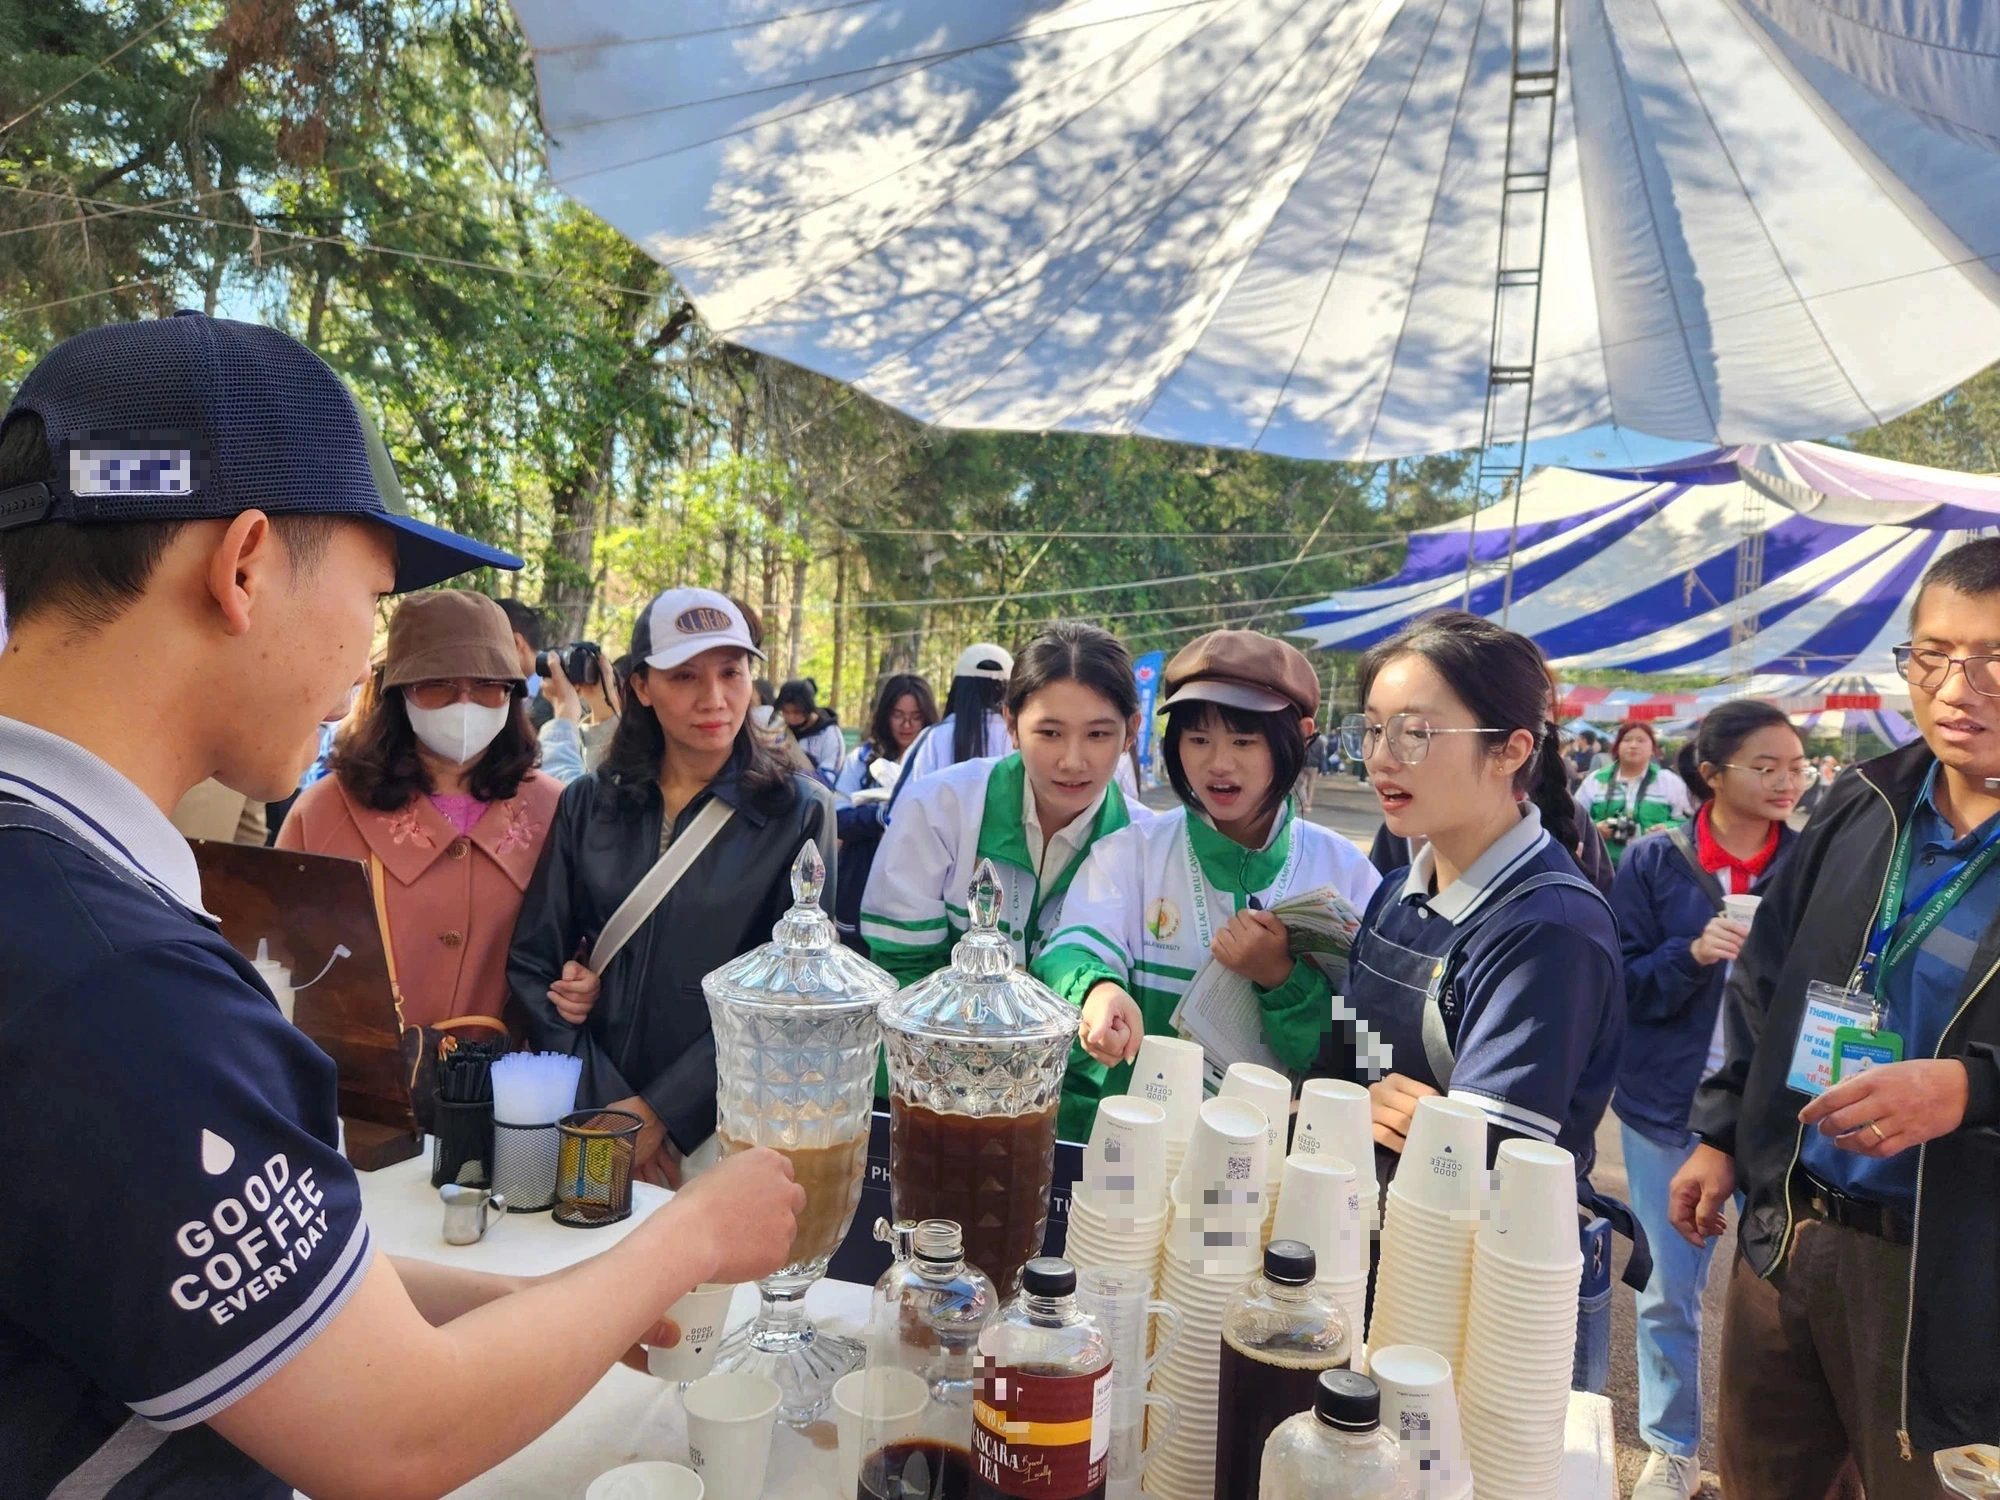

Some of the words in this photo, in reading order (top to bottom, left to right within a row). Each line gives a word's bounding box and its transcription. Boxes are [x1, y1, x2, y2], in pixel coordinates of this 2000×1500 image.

[1144, 1084, 1173, 1096] COFFEE
[1147, 1092, 1167, 1102] GOOD
[1429, 1157, 1463, 1171] COFFEE
[1433, 1166, 1457, 1178] GOOD
[176, 1153, 291, 1258] GOOD
[171, 1168, 325, 1311] COFFEE
[209, 1210, 329, 1326] EVERYDAY
[685, 1330, 714, 1341] COFFEE
[691, 1325, 712, 1335] GOOD
[972, 1421, 1019, 1470] CASCARA
[978, 1452, 1000, 1486] TEA
